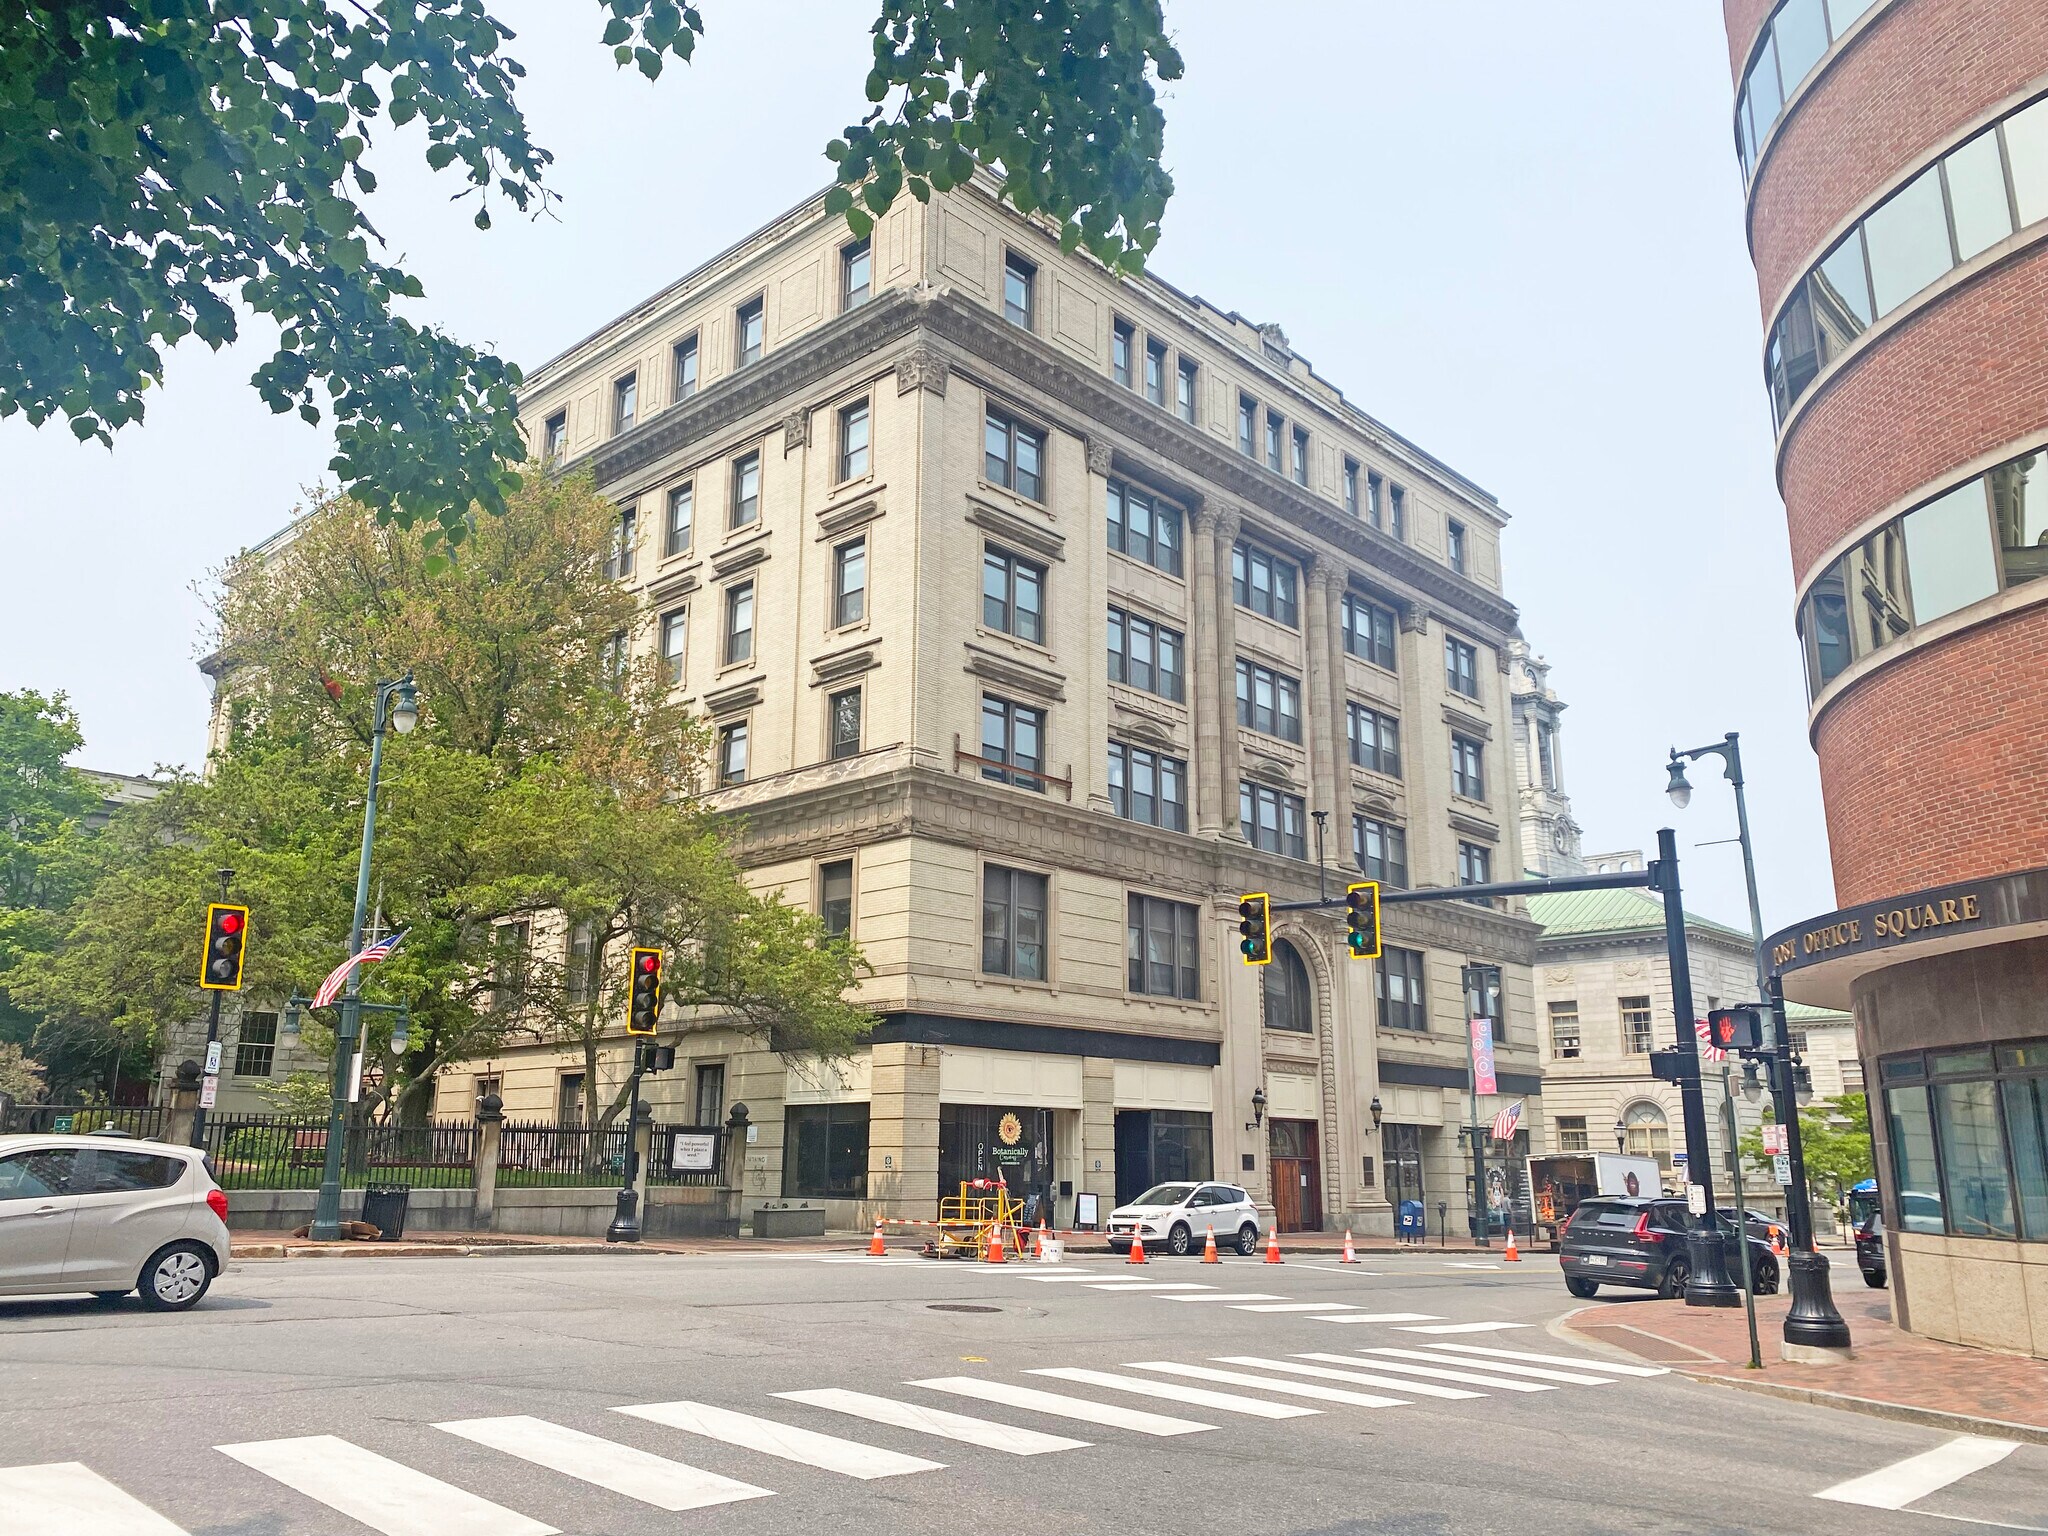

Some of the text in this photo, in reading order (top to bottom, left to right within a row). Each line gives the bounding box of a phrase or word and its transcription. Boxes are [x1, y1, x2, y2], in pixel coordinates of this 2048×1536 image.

[1773, 894, 1982, 967] POST OFFICE SQUARE
[977, 1142, 985, 1172] OPEN
[992, 1147, 1029, 1158] Botanically
